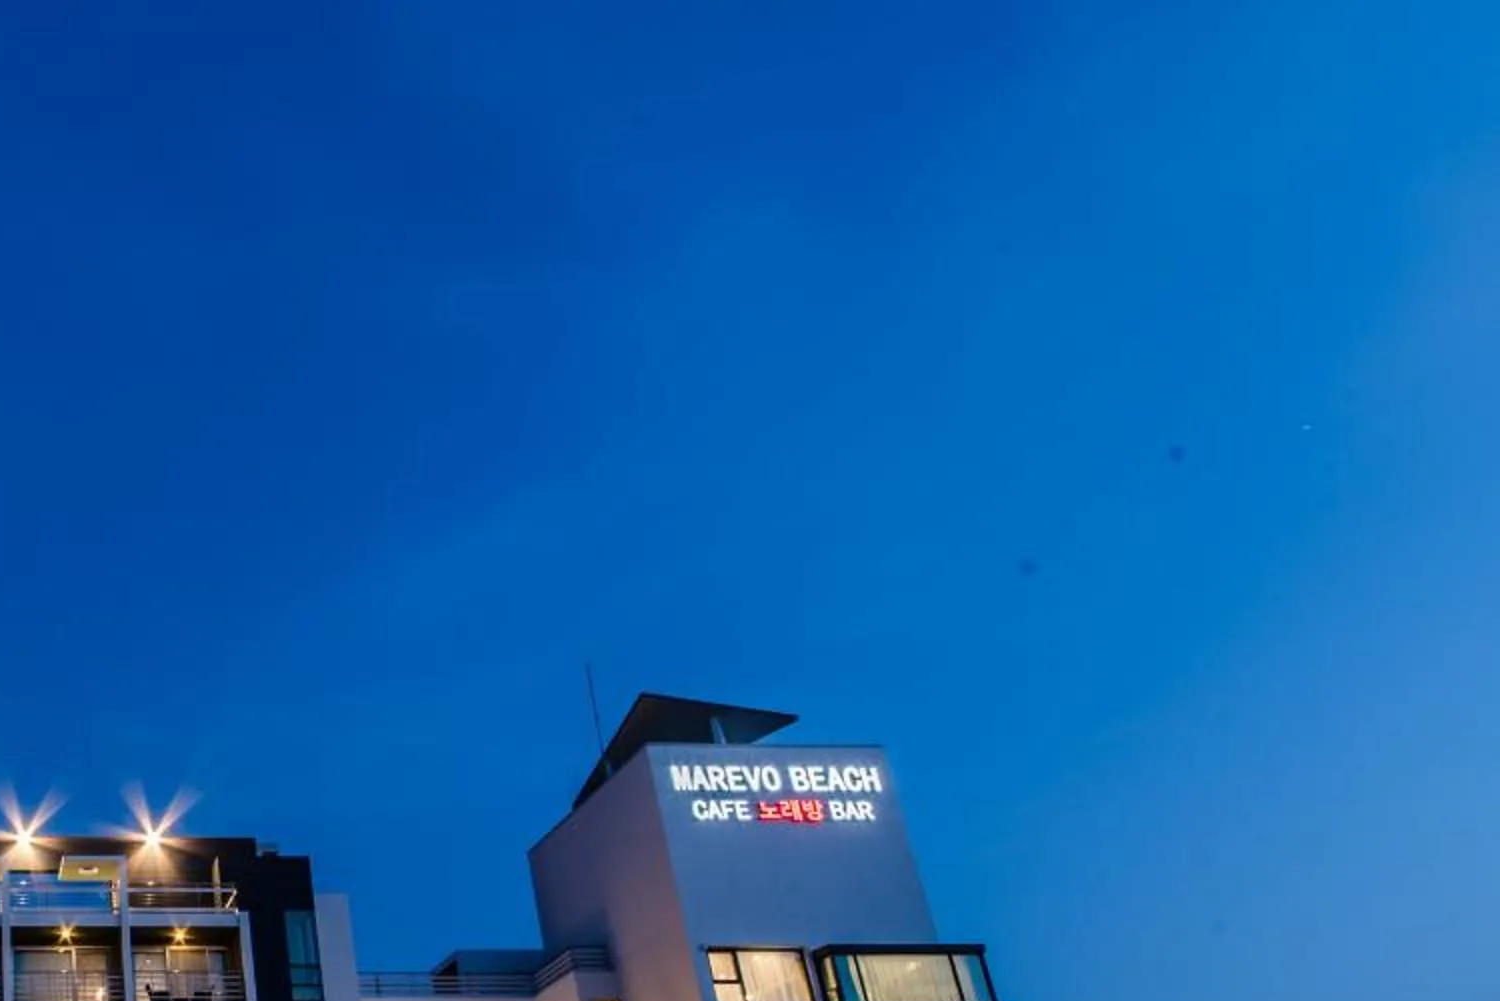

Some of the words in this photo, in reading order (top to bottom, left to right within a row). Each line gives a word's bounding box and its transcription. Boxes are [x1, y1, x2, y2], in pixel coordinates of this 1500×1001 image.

[670, 764, 781, 792] MAREVO
[788, 765, 882, 793] BEACH
[692, 800, 751, 821] CAFE
[759, 799, 823, 823] 노래방
[829, 800, 876, 821] BAR
